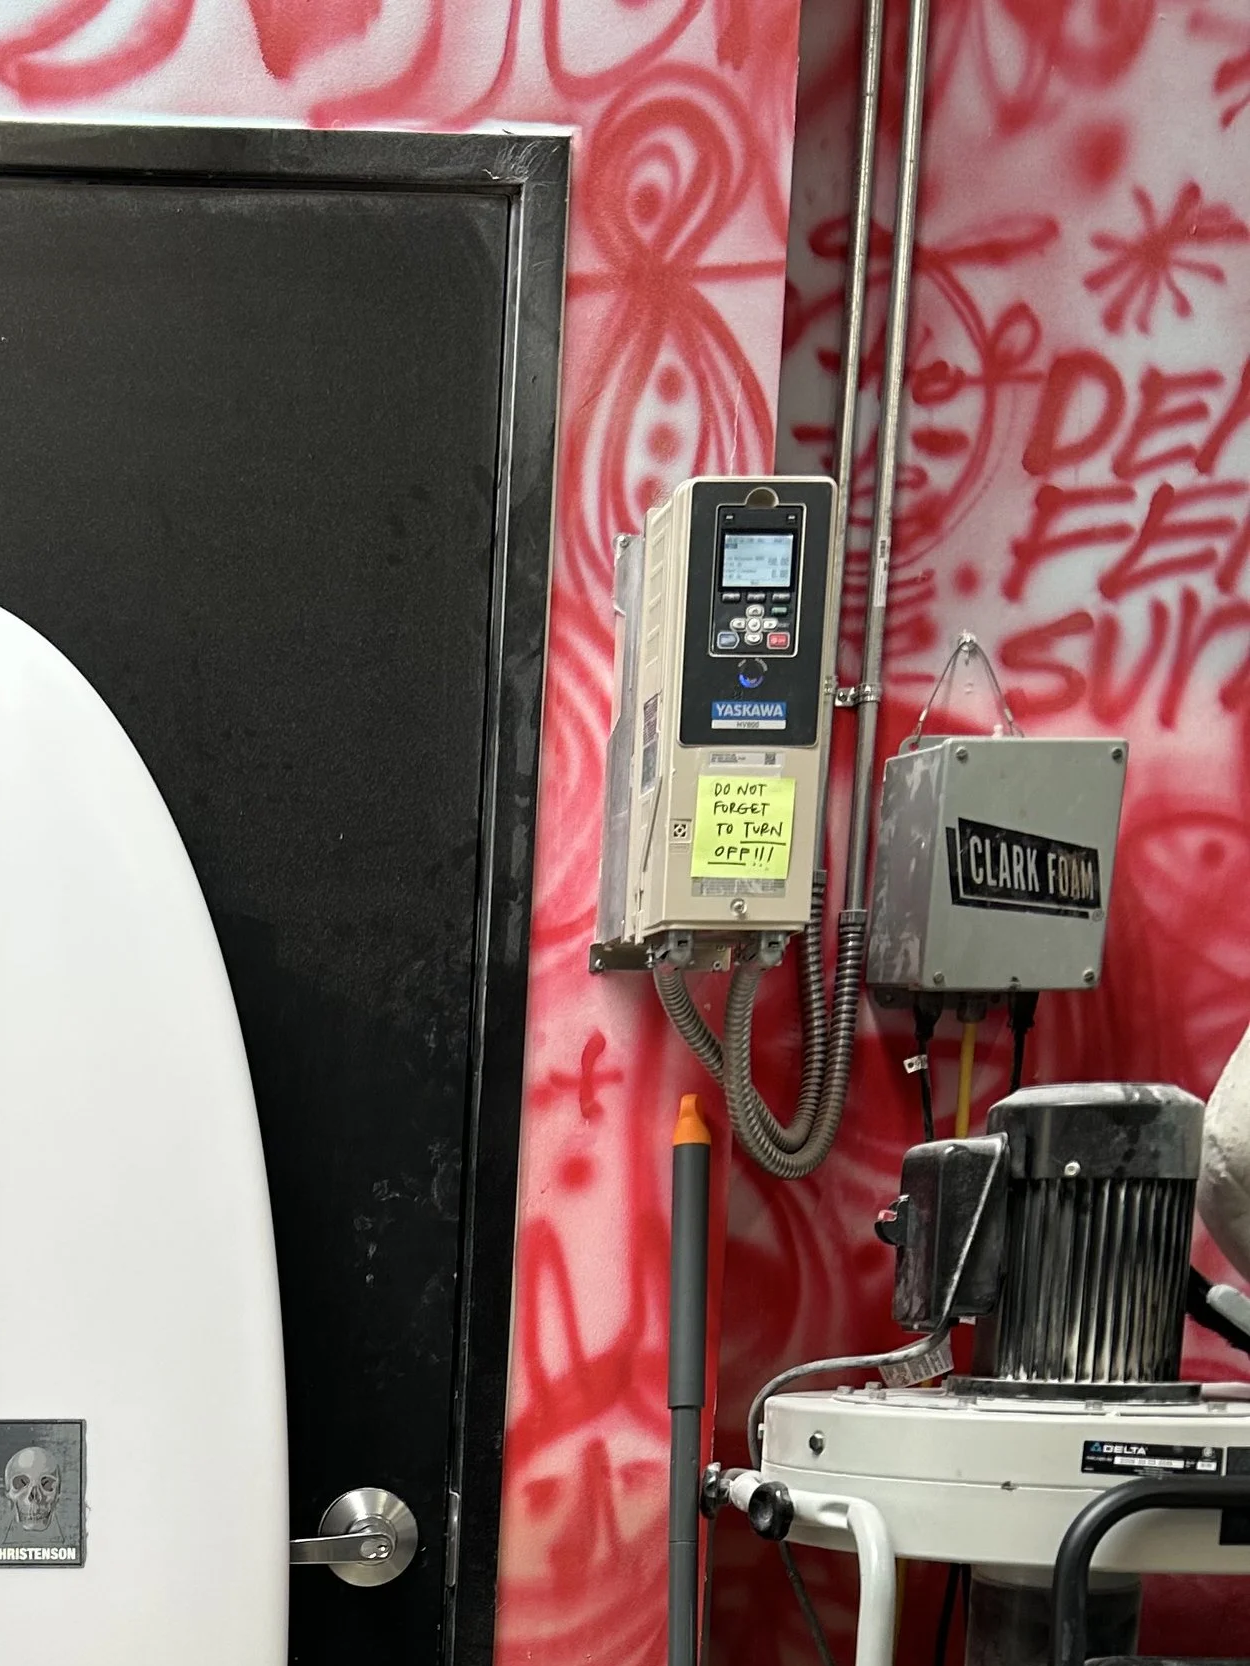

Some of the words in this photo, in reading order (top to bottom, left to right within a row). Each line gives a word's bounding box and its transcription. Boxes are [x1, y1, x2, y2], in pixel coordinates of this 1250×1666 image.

[1022, 350, 1250, 480] DE
[1001, 481, 1250, 604] FE
[716, 703, 783, 717] YASKAWA
[714, 782, 731, 797] DO
[737, 781, 768, 797] NOT
[713, 800, 770, 815] FORGET
[716, 822, 734, 837] TO
[743, 821, 783, 838] TURN
[714, 846, 774, 871] OFF!!!
[969, 835, 1040, 893] CLARK
[1046, 852, 1094, 901] FOAM
[1102, 1444, 1146, 1455] DELTA
